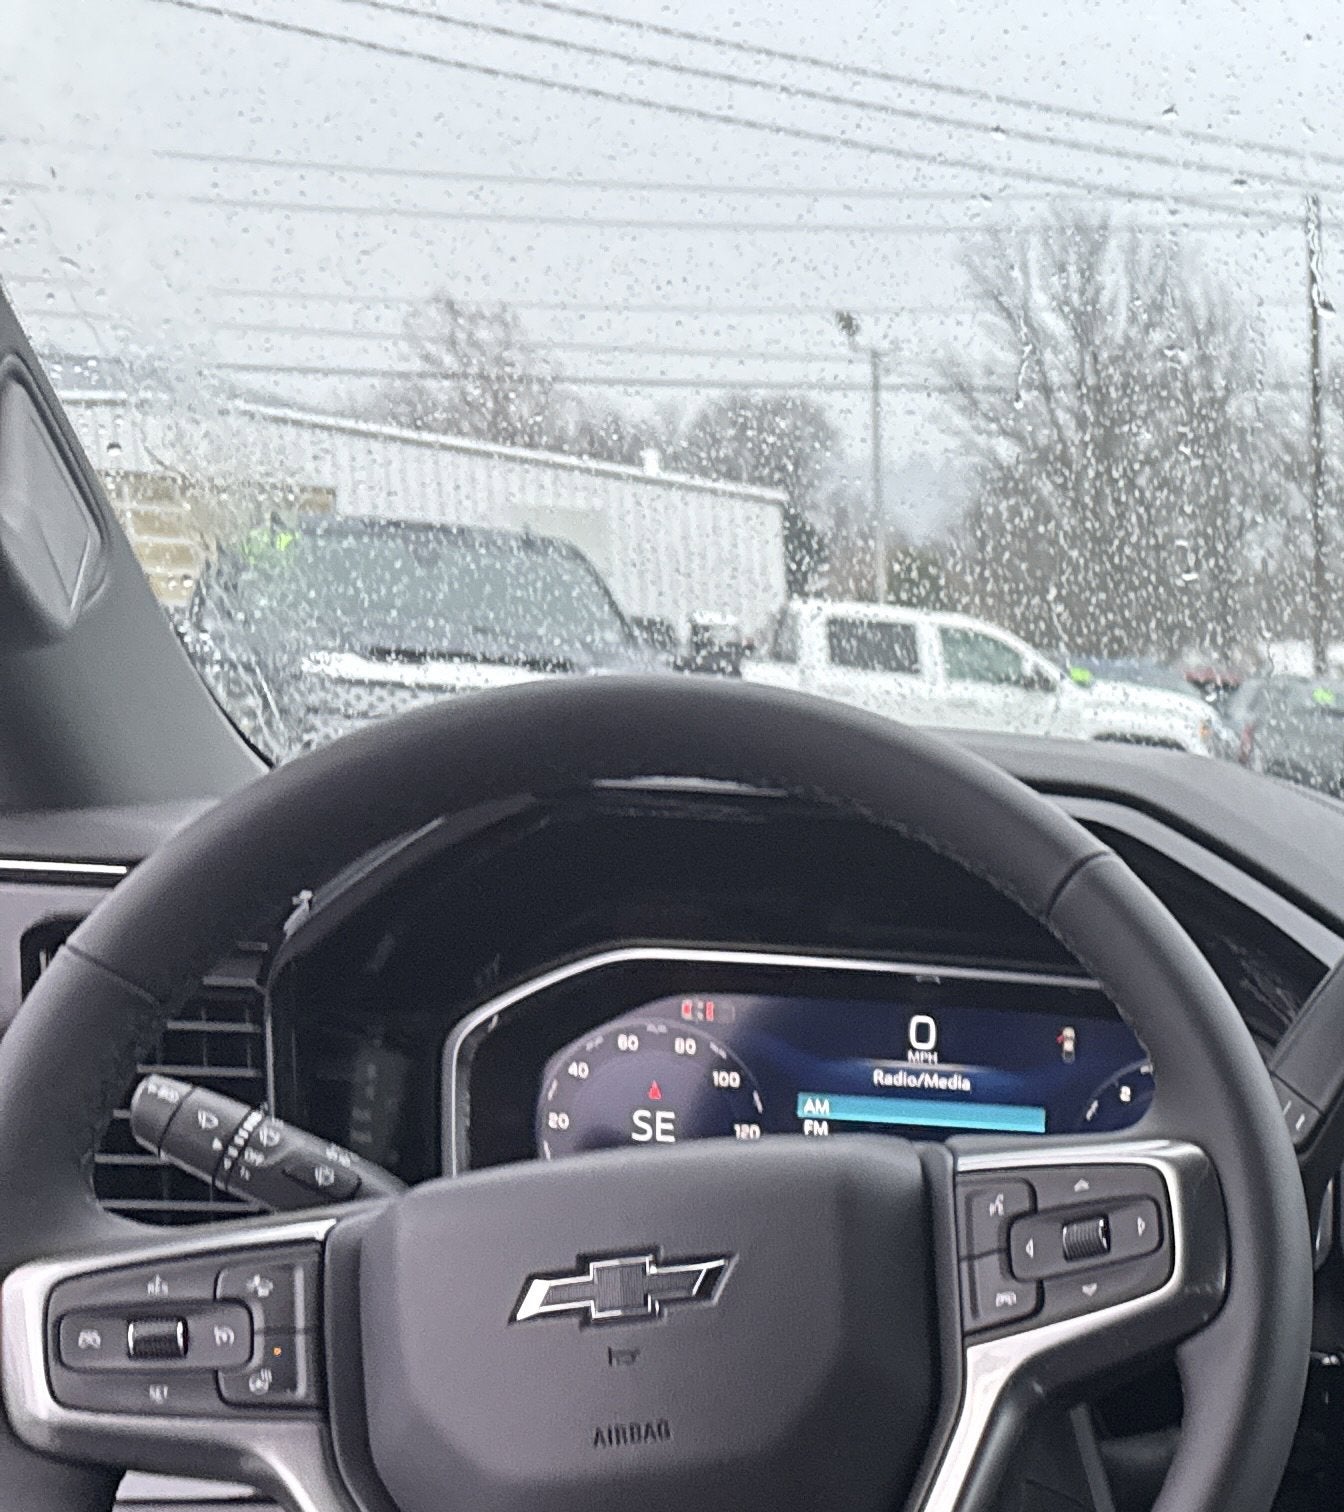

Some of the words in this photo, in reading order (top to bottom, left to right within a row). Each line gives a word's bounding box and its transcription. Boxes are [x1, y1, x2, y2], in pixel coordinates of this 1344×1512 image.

[909, 1015, 937, 1050] 0
[617, 1033, 639, 1051] 60
[907, 1050, 938, 1065] MPH
[567, 1061, 589, 1079] 40
[712, 1070, 741, 1088] 100
[873, 1069, 972, 1092] Radio/Media
[803, 1097, 830, 1116] AM
[548, 1112, 569, 1129] 20
[631, 1109, 676, 1142] SE
[803, 1119, 829, 1136] FM
[593, 1418, 671, 1448] AIRBAG
